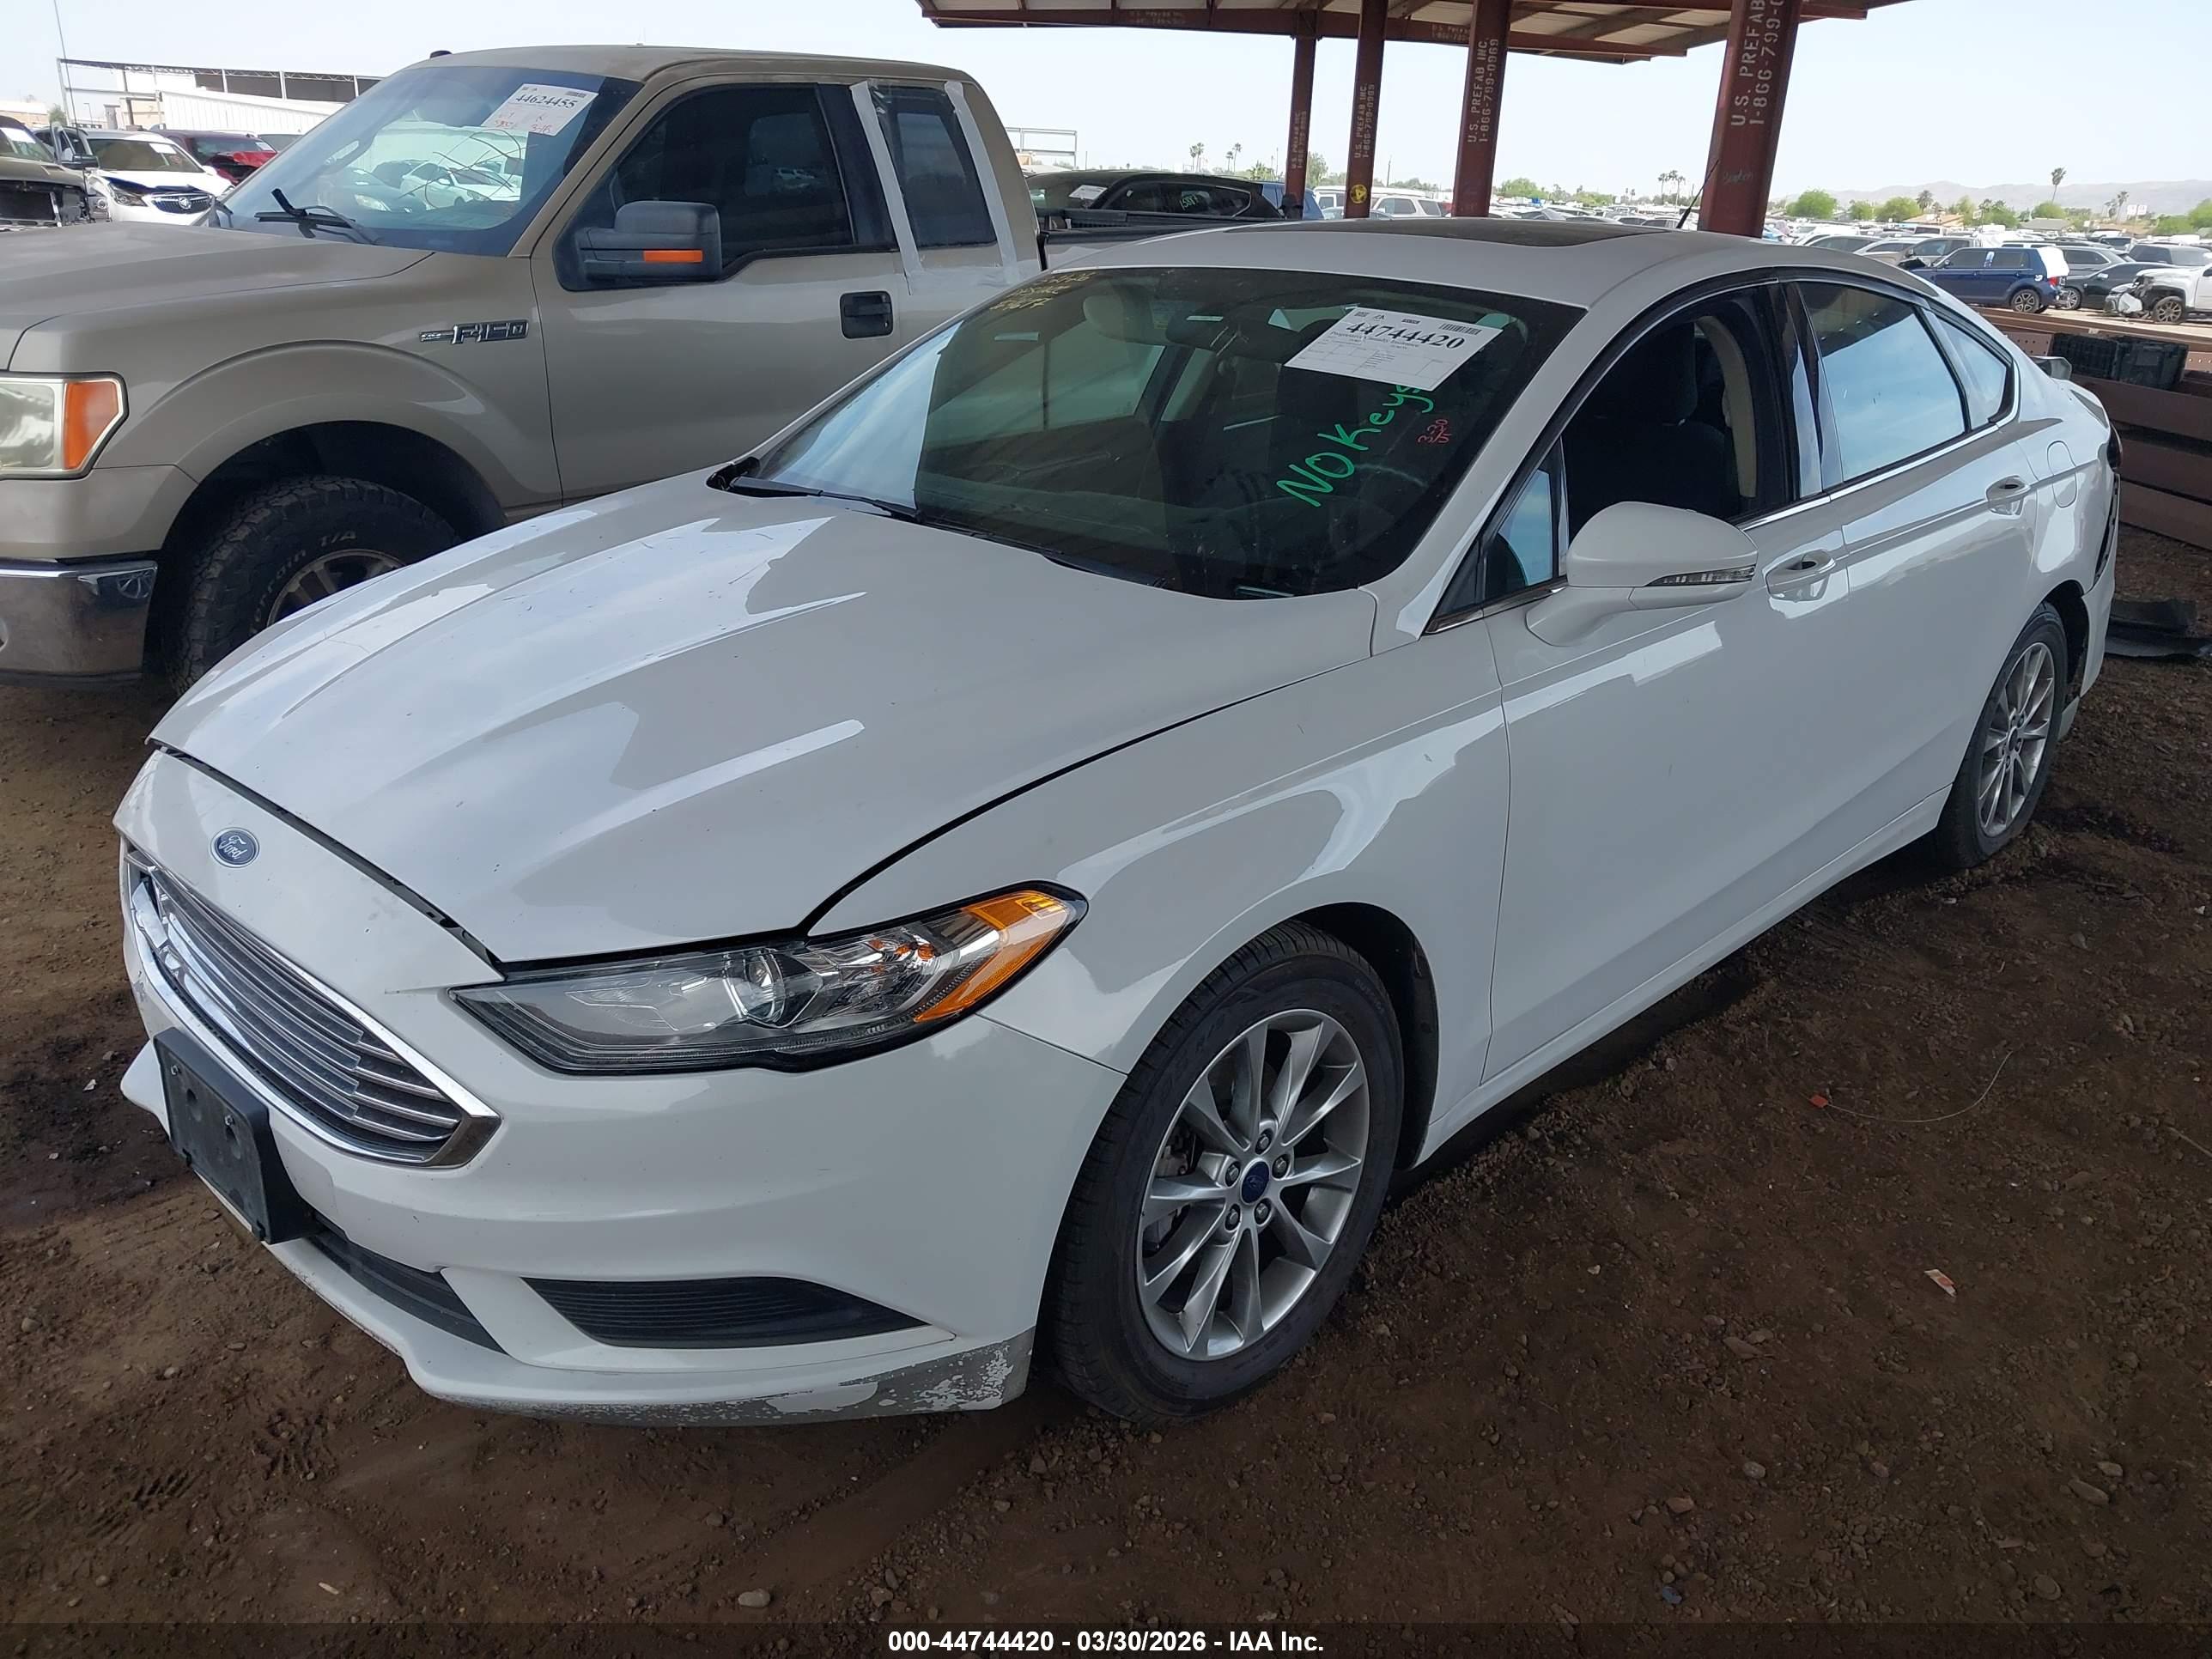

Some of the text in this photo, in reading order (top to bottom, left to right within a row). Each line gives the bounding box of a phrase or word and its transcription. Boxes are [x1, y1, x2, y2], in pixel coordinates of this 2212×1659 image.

[1731, 0, 1765, 126] U.S. PREFAB
[516, 94, 578, 108] 44624455
[1471, 67, 1485, 113] PREFAB
[1468, 119, 1480, 143] U.S.
[1346, 323, 1466, 349] 44744420
[1276, 452, 1355, 507] NO
[218, 835, 248, 860] Ford
